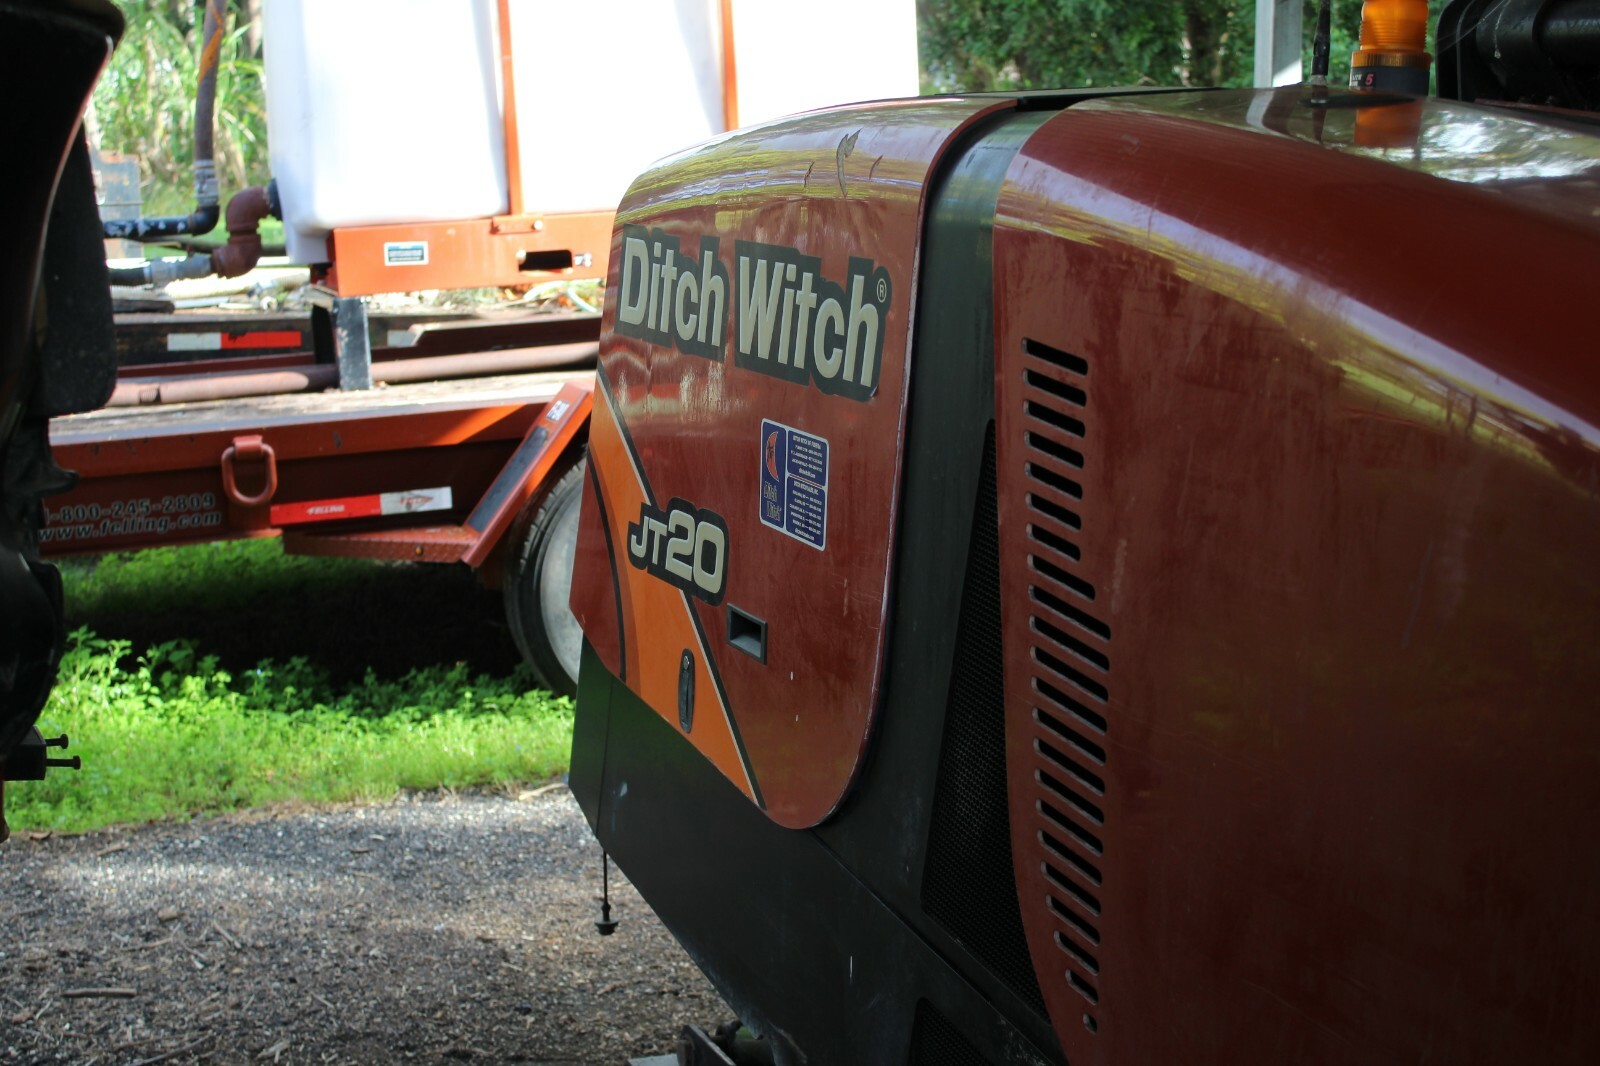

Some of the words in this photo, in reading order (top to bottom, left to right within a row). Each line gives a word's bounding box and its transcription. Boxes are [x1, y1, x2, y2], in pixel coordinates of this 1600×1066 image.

[619, 236, 725, 348] Ditch
[38, 511, 221, 543] www.felling.com
[630, 509, 725, 594] JT20
